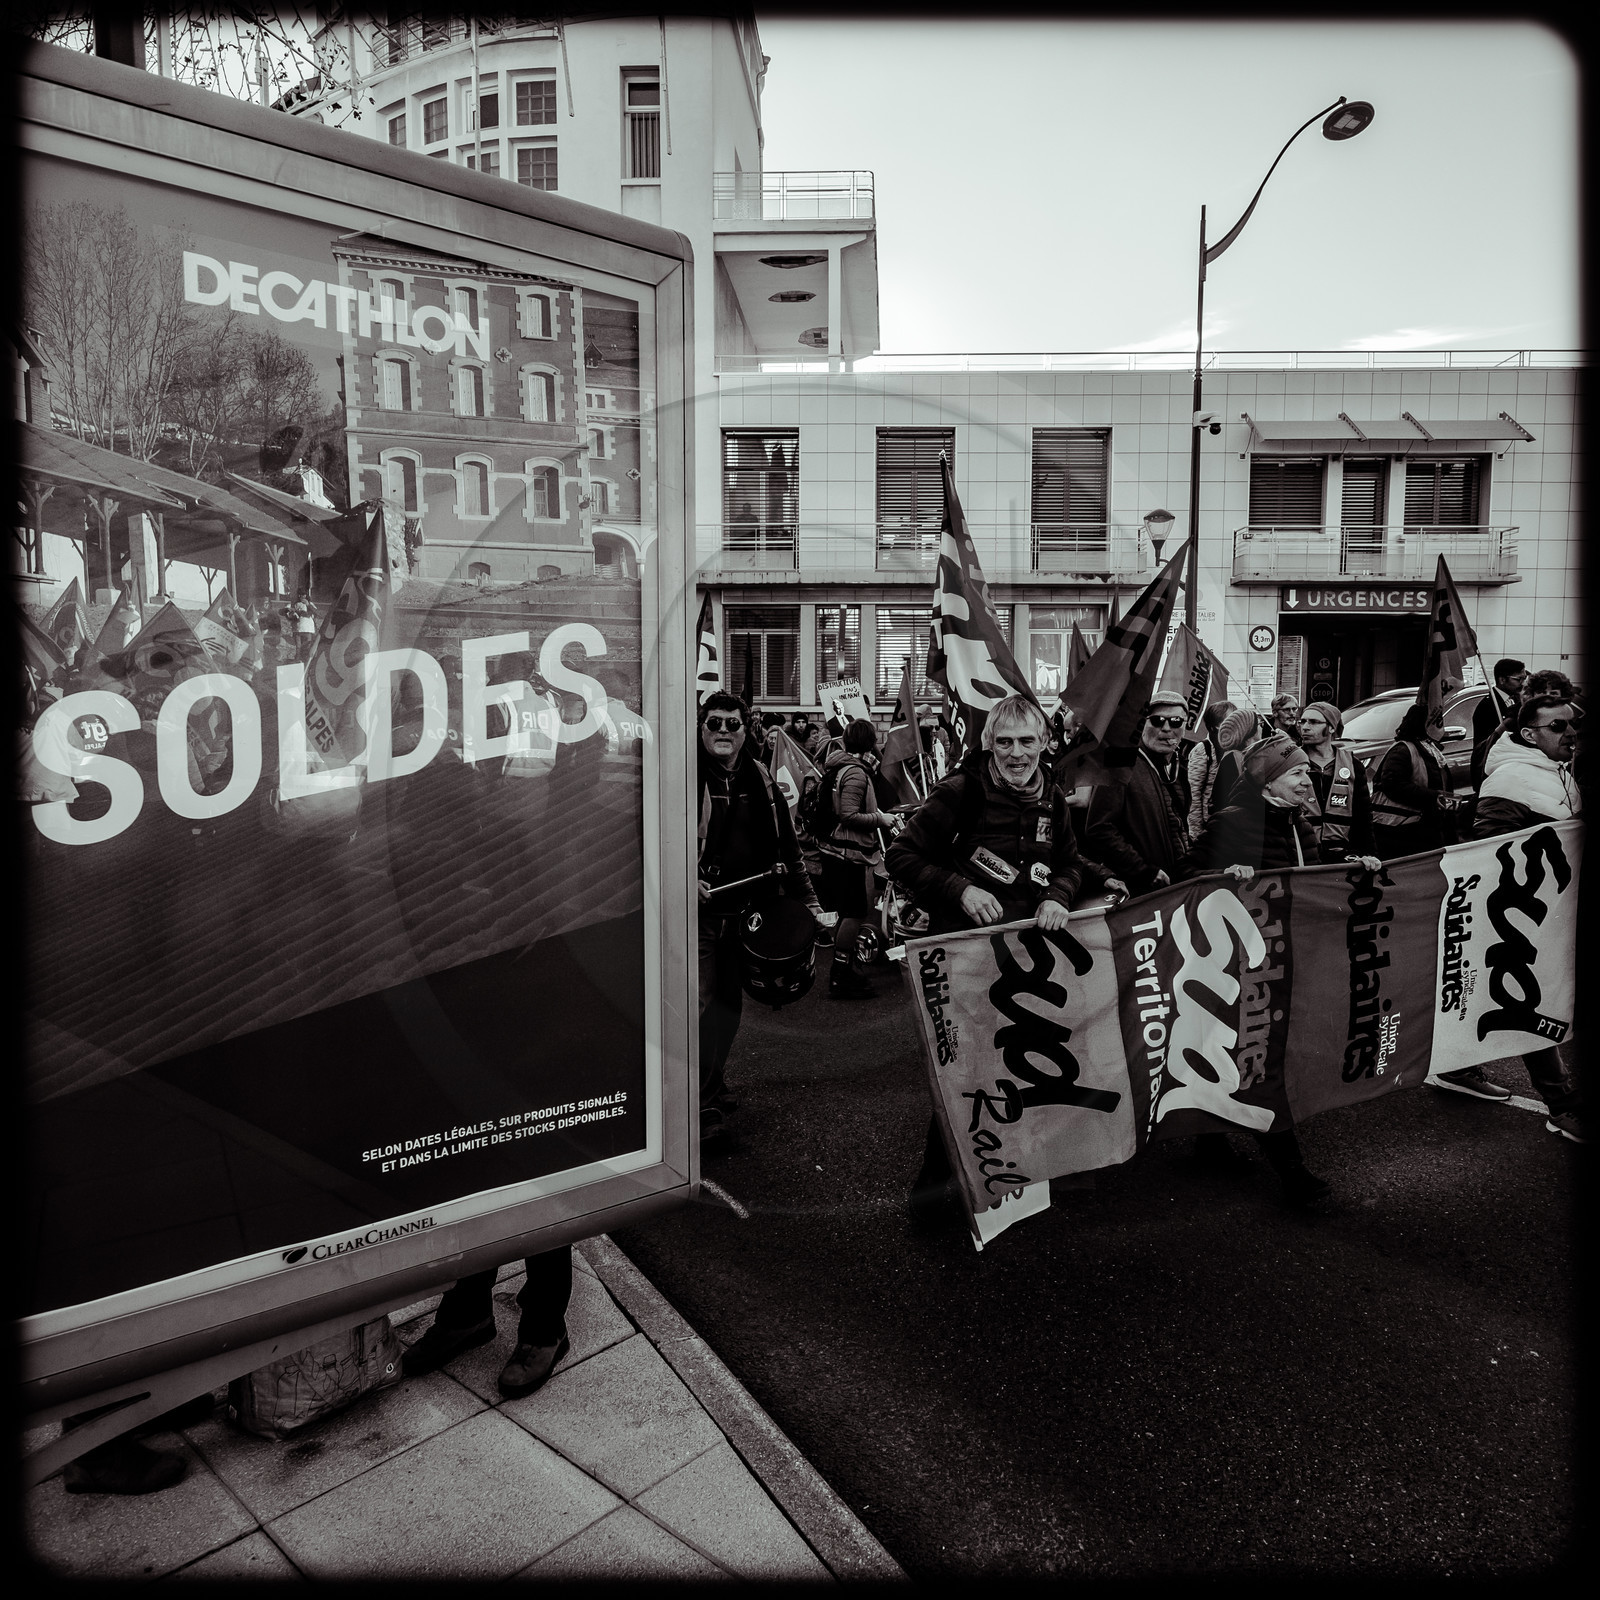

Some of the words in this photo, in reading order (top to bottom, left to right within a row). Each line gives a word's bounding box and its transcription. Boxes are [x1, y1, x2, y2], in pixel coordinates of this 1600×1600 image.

[183, 250, 490, 362] DECATHLON
[1307, 590, 1428, 607] URGENCES
[31, 622, 609, 846] SOLDES
[1441, 874, 1482, 1013] Solidaires
[918, 947, 954, 1067] Solidaires
[1468, 968, 1478, 995] Union
[1376, 1015, 1391, 1076] syndicale
[1388, 1011, 1401, 1054] Union
[1536, 1018, 1565, 1039] PTT
[362, 1142, 402, 1163] SELON
[404, 1133, 442, 1152] DATES
[444, 1121, 497, 1142] LÉGALES,
[499, 1113, 522, 1130] SUR
[523, 1102, 576, 1124] PRODUITS
[577, 1091, 628, 1112] SIGNALÉS
[381, 1160, 397, 1174] ET
[399, 1151, 431, 1169] DANS
[433, 1146, 449, 1160] LA
[451, 1137, 489, 1156] LIMITE
[491, 1130, 513, 1146] DES
[514, 1120, 556, 1140] STOCKS
[557, 1106, 627, 1129] DISPONIBLES.
